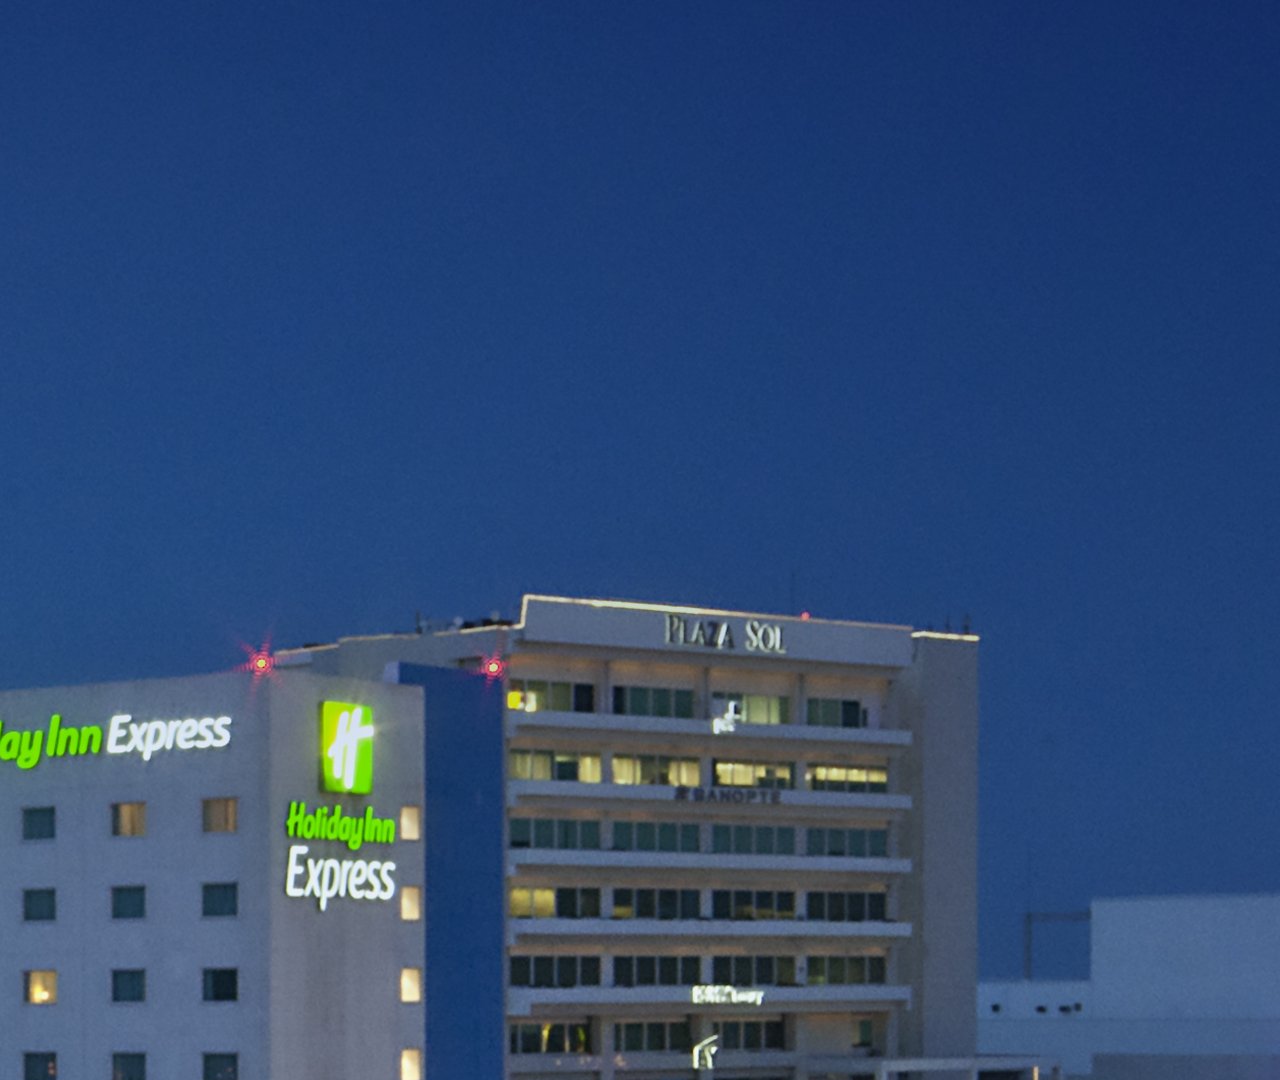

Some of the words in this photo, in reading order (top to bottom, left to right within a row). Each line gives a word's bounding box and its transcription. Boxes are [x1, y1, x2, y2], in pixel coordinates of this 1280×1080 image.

[664, 613, 735, 650] PLAZA
[744, 620, 787, 654] SOL
[46, 713, 103, 757] Inn
[106, 714, 233, 761] Express
[286, 800, 365, 850] Holiday
[363, 805, 396, 844] Inn
[286, 845, 397, 912] Express
